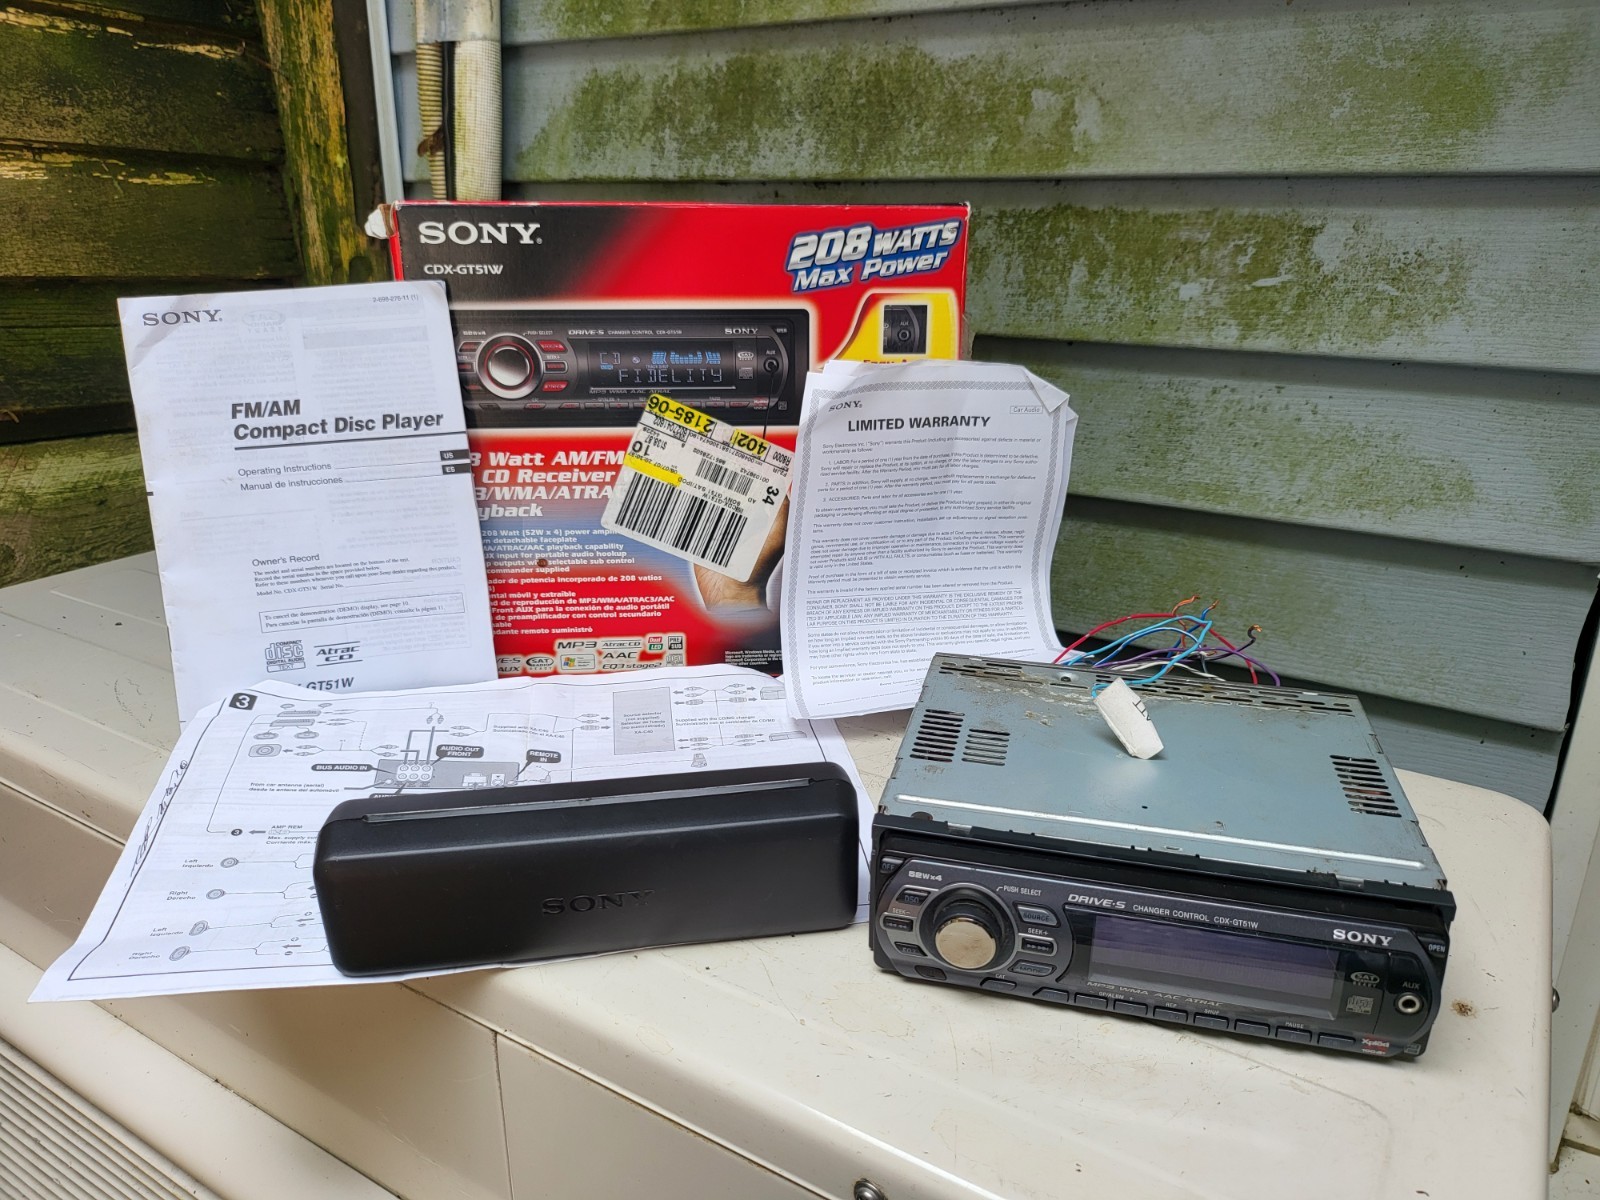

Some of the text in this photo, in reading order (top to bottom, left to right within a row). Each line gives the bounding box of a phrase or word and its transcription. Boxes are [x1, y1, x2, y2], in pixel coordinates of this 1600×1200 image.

[418, 222, 540, 244] SONY
[787, 221, 960, 271] 208 WATTS
[424, 264, 503, 275] CDX-GT51W
[793, 251, 948, 292] Max Power
[142, 308, 220, 327] SONY
[600, 352, 620, 364] CD
[619, 368, 722, 382] FIDELITY
[231, 400, 301, 420] FM/AM
[828, 400, 860, 412] SONY
[646, 395, 715, 433] 2185-06
[234, 412, 444, 440] Compact Disc Player
[848, 416, 991, 432] LIMITED WARRANTY
[630, 439, 652, 457] 10
[735, 433, 768, 456] 402
[444, 452, 454, 460] US
[489, 452, 544, 466] Watt
[552, 451, 625, 466] AM/FM
[238, 462, 332, 480] Operating Instructions
[482, 469, 616, 483] CD Receiver
[240, 476, 343, 492] Manual de instrucciones
[476, 486, 614, 500] 3/WMA/ATRA
[761, 484, 779, 505] 34
[479, 504, 543, 521] yback
[540, 536, 577, 544] faceplate
[252, 554, 320, 566] Owner's Record
[596, 550, 627, 558] hookup
[536, 566, 570, 574] supplied
[521, 577, 555, 585] potencia
[558, 576, 606, 584] incorporado
[513, 598, 565, 606] reproducción
[565, 604, 602, 612] conexión
[640, 603, 670, 611] portátil
[508, 613, 570, 621] preamplificador
[265, 643, 304, 660] disc
[316, 646, 360, 656] Atrac
[324, 654, 354, 662] CD
[306, 677, 354, 690] GT51W
[237, 694, 250, 708] 3
[530, 750, 558, 758] REMOTE
[1004, 885, 1042, 896] PUSH SELECT
[542, 890, 655, 914] SONY
[1023, 912, 1050, 922] SOURCE
[1133, 904, 1170, 916] CHANGER
[1172, 910, 1210, 922] CONTROL
[1214, 916, 1259, 929] CDX-GT51W
[1333, 929, 1392, 946] SONY
[1428, 944, 1446, 952] OPEN
[1402, 981, 1420, 990] AUX
[1120, 987, 1148, 995] WMA
[1154, 992, 1181, 1000] AAC
[1185, 998, 1224, 1006] ATRAC
[1286, 1021, 1304, 1029] PAUSE
